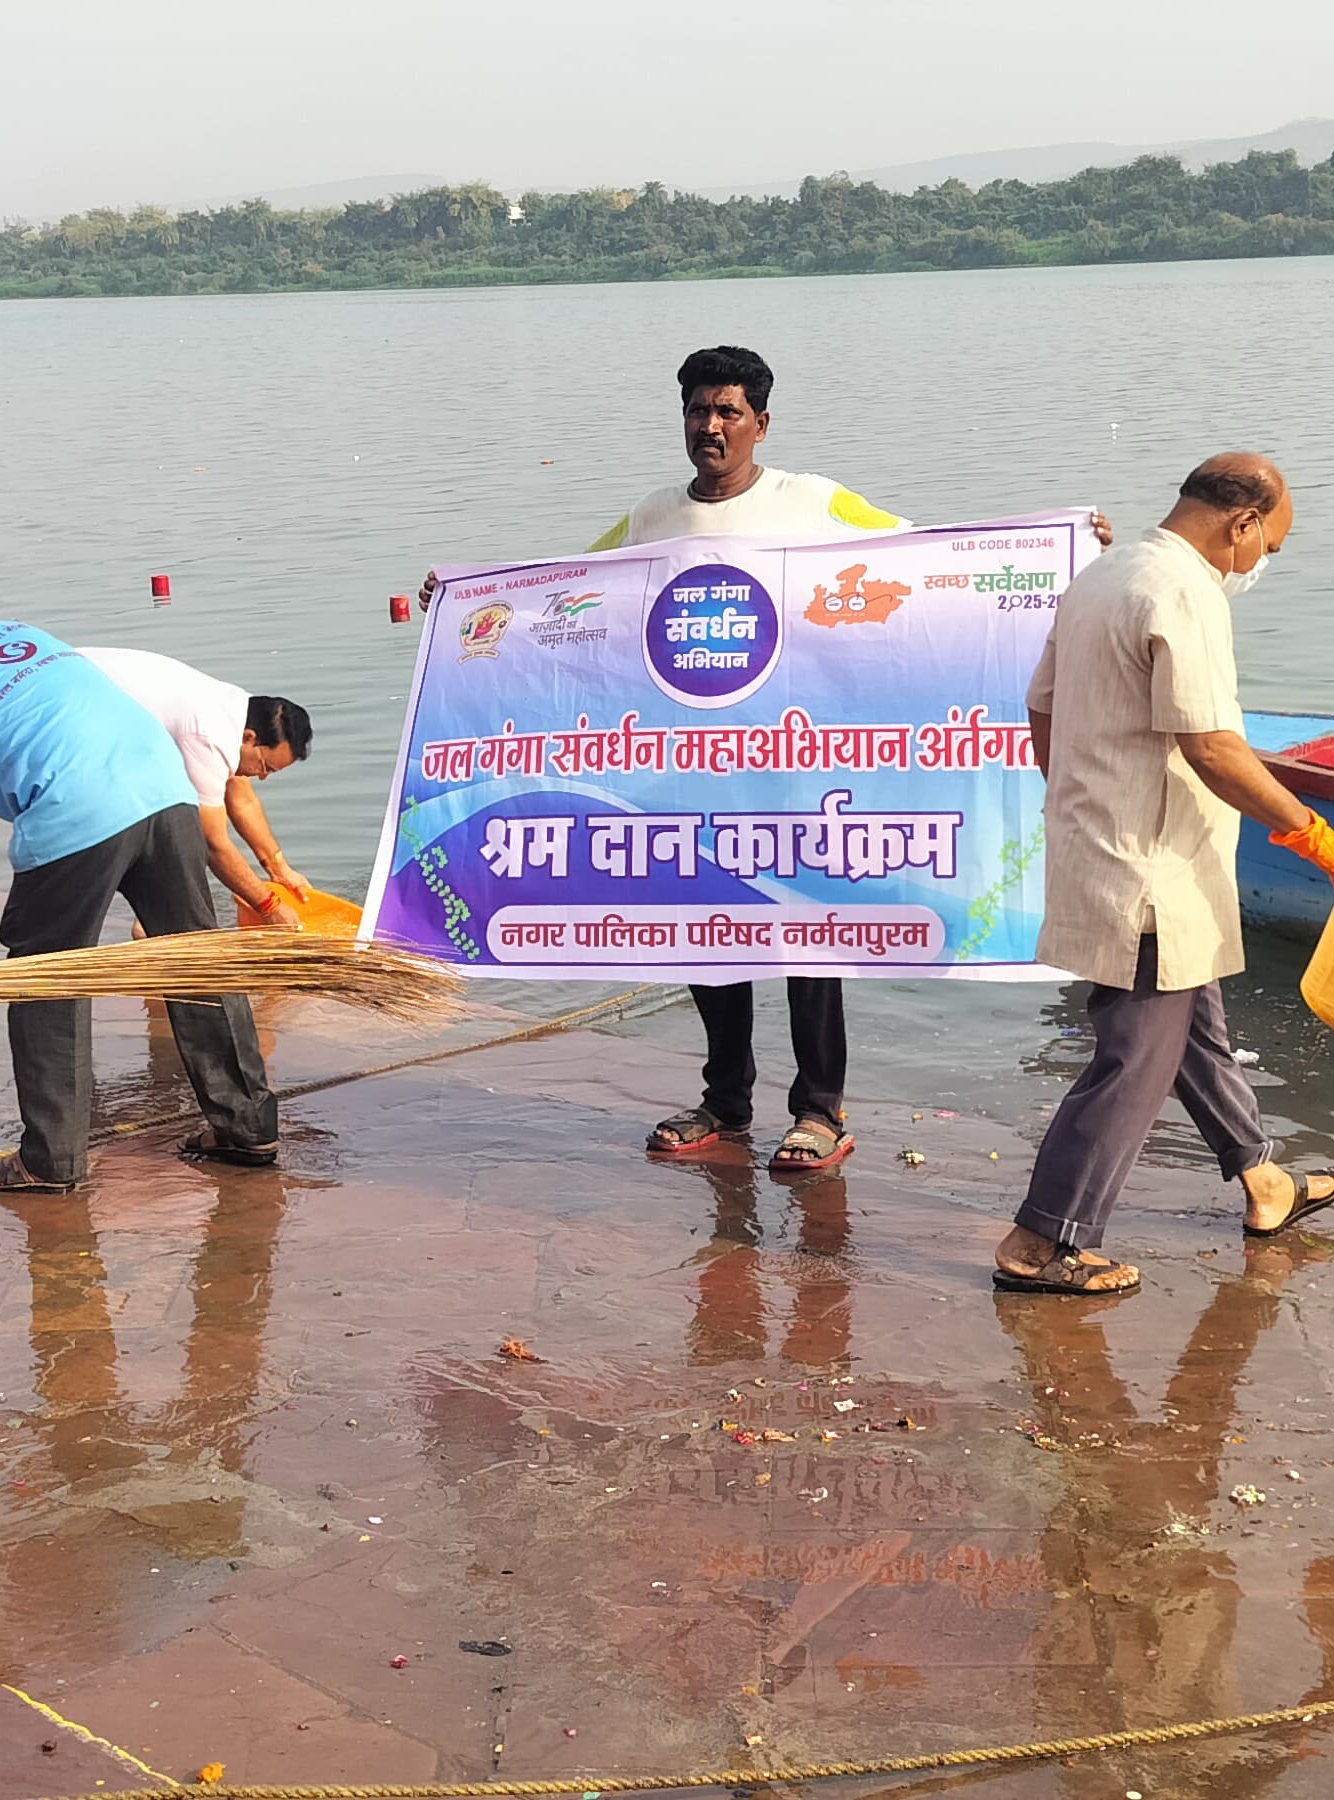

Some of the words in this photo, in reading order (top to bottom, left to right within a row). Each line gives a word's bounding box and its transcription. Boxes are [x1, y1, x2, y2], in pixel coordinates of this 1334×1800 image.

[952, 540, 975, 551] ULB
[979, 539, 1012, 550] CODE
[1015, 537, 1055, 549] 802346
[454, 587, 472, 600] ULB
[472, 583, 498, 598] NAME
[505, 567, 589, 591] NARMADAPURAM
[672, 586, 707, 603] जल
[710, 580, 751, 602] गंगा
[923, 574, 970, 590] स्वच्छ
[972, 565, 1057, 592] सर्वेक्षण
[537, 631, 565, 650] अमृत
[566, 626, 609, 645] महोत्सव
[665, 607, 758, 642] संवर्धन
[672, 647, 749, 669] अभियान
[424, 740, 476, 780] जल
[480, 721, 546, 776] गंगा
[551, 713, 667, 773] संवर्धन
[673, 709, 910, 773] महाअभियान
[478, 816, 576, 878] श्रम
[587, 814, 704, 878] दान
[712, 790, 962, 882] कार्यक्रम
[499, 922, 566, 949] नगर
[573, 913, 677, 948] पालिका
[685, 914, 773, 948] परिषद
[780, 912, 931, 956] नर्मदापुरम
